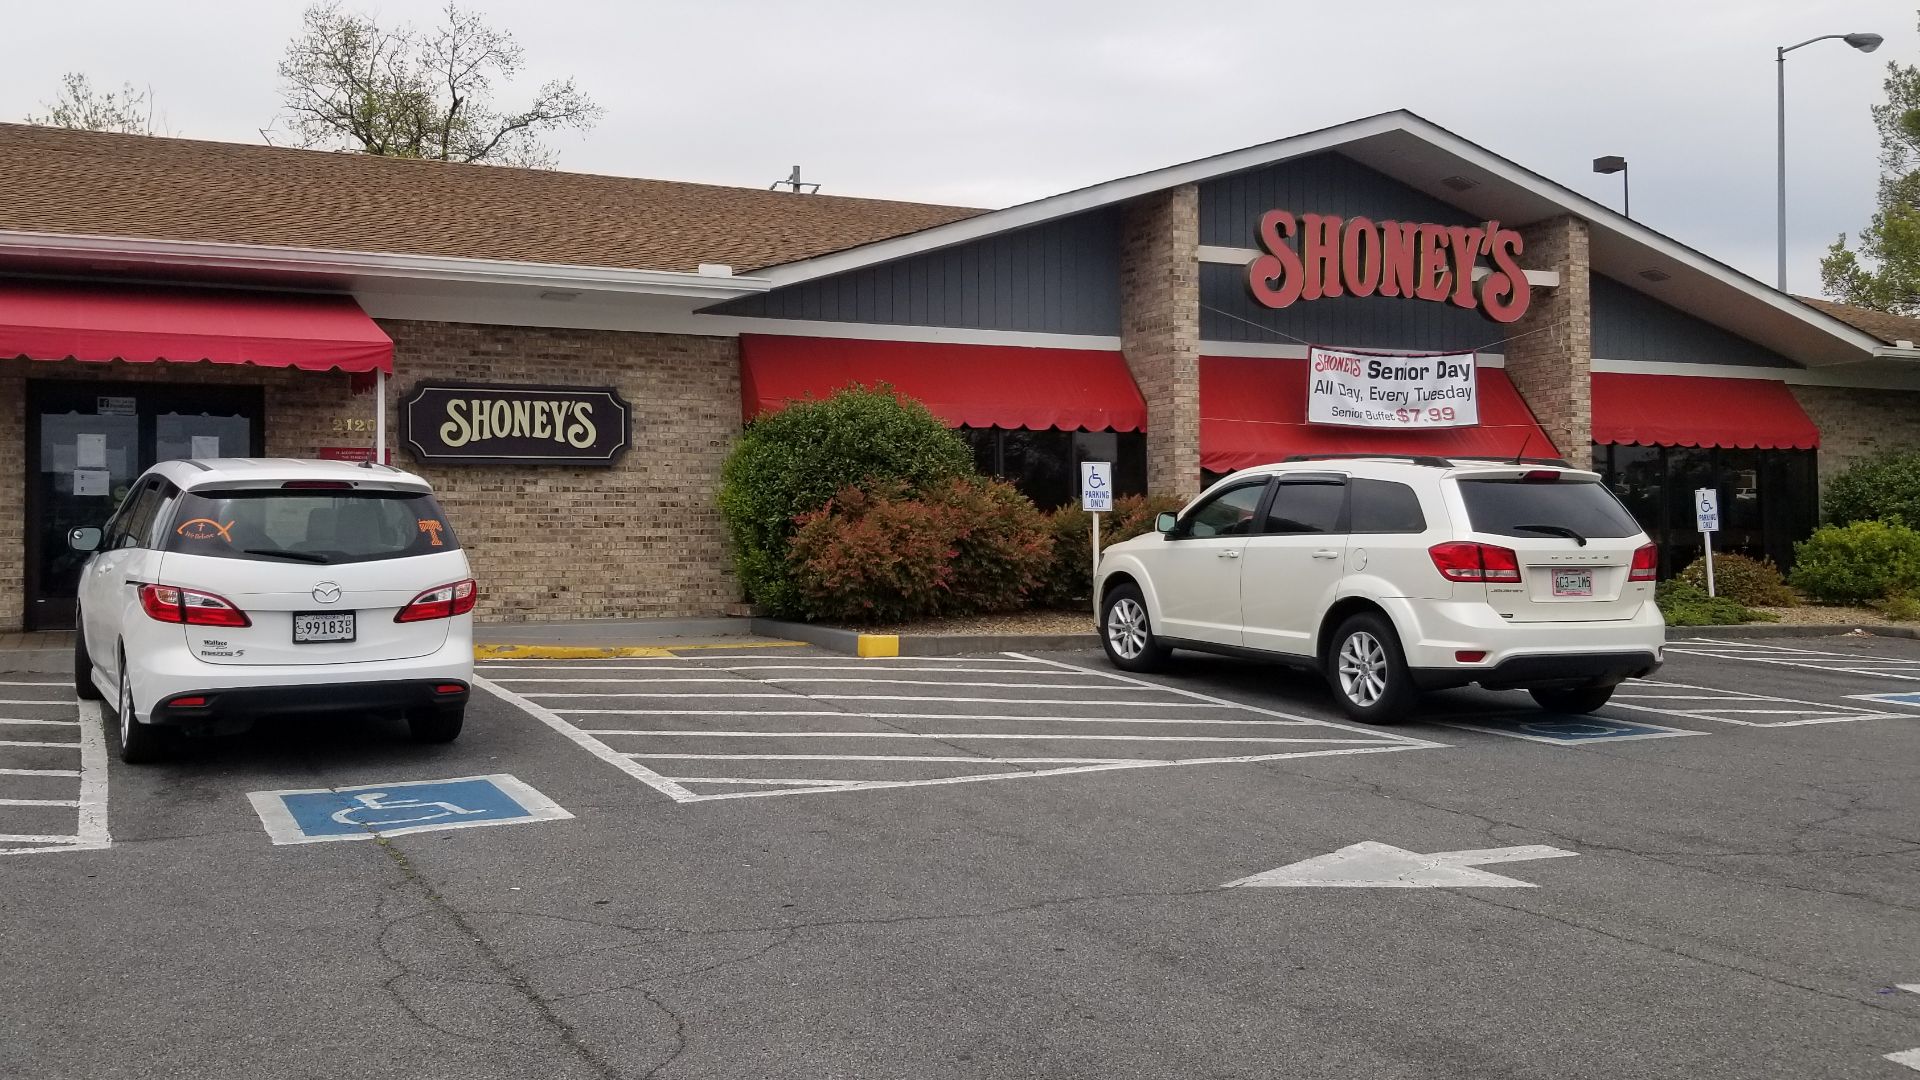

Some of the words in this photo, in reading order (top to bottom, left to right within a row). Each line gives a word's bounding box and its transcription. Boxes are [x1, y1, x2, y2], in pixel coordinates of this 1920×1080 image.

[1249, 208, 1531, 323] SHONEY'S
[1367, 360, 1430, 381] Senior
[1436, 360, 1471, 382] Day
[1314, 379, 1334, 395] All
[1337, 382, 1363, 402] Day,
[1369, 386, 1409, 405] Every
[1413, 385, 1472, 402] Tuesday
[440, 398, 597, 449] SHONEY'S
[1331, 406, 1364, 419] Senior
[1365, 410, 1396, 421] Buffet
[1396, 407, 1456, 423] $7.99
[1085, 490, 1110, 499] PARKING
[1090, 499, 1105, 508] ONLY
[305, 620, 344, 635] 99183
